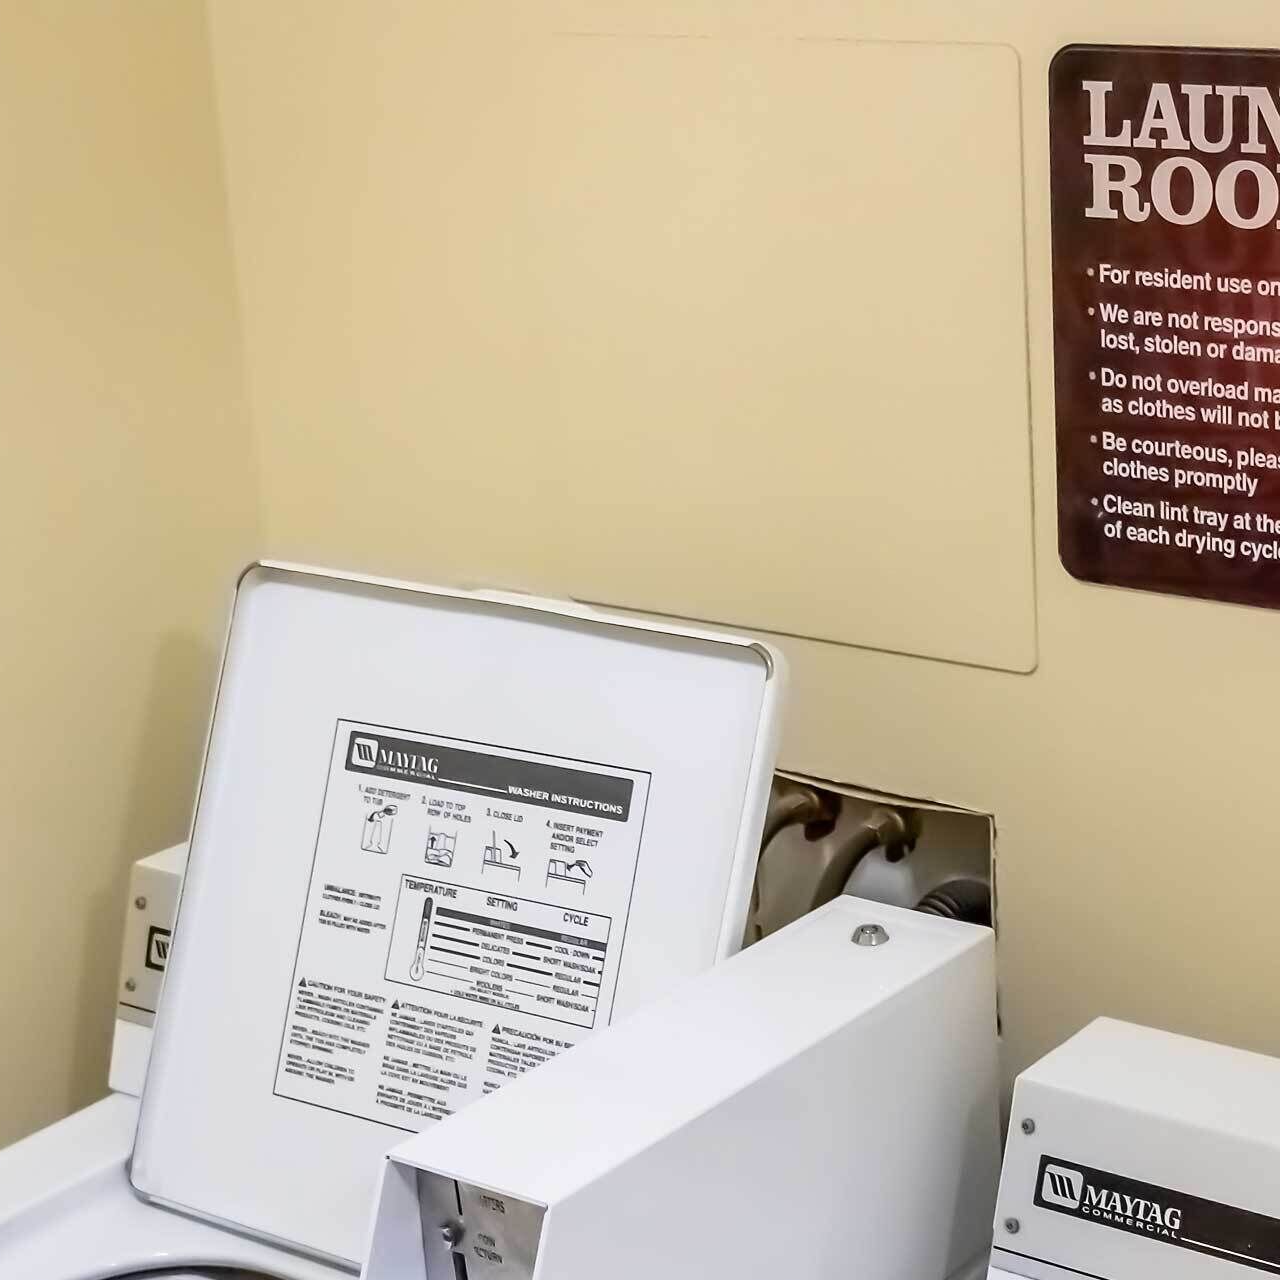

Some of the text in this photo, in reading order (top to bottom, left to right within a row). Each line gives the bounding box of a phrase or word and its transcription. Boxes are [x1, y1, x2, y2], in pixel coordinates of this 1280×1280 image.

[1099, 263, 1130, 285] For
[1135, 268, 1212, 291] resident
[1217, 276, 1252, 295] use
[1099, 302, 1129, 324] We
[1134, 308, 1163, 327] are
[1168, 308, 1200, 330] not
[1100, 328, 1140, 354] lost,
[1144, 333, 1202, 357] stolen
[1206, 340, 1227, 359] or
[1101, 367, 1127, 389] Do
[1132, 372, 1162, 393] not
[1167, 377, 1249, 401] overload
[1101, 396, 1122, 415] as
[1128, 396, 1196, 422] clothes
[1200, 404, 1233, 425] will
[1237, 408, 1269, 430] not
[1102, 431, 1127, 453] Be
[1131, 437, 1233, 468] courteous,
[1102, 458, 1259, 497] clothes promptly
[1102, 493, 1155, 519] Clean
[1159, 501, 1189, 523] lint
[1193, 505, 1229, 531] tray
[1233, 511, 1252, 530] at
[1104, 521, 1123, 539] of
[1126, 525, 1170, 546] each
[1174, 532, 1236, 559] drying
[379, 749, 439, 774] MAYTAG
[429, 799, 444, 808] LOAD
[446, 801, 453, 809] TO
[508, 786, 623, 815] WASHER INSTRUCTIONS
[493, 810, 512, 820] CLOSE
[513, 814, 523, 822] LID
[553, 822, 574, 832] INSERT
[576, 826, 603, 837] PAYMENT
[550, 843, 575, 853] SETTING
[575, 837, 598, 847] SELECT
[405, 879, 457, 898] TEMPERATURE
[486, 896, 518, 911] SETTING
[563, 912, 589, 926] CYCLE
[1085, 1185, 1182, 1230] MAYTAG
[1082, 1206, 1178, 1239] COMMERCIAL
